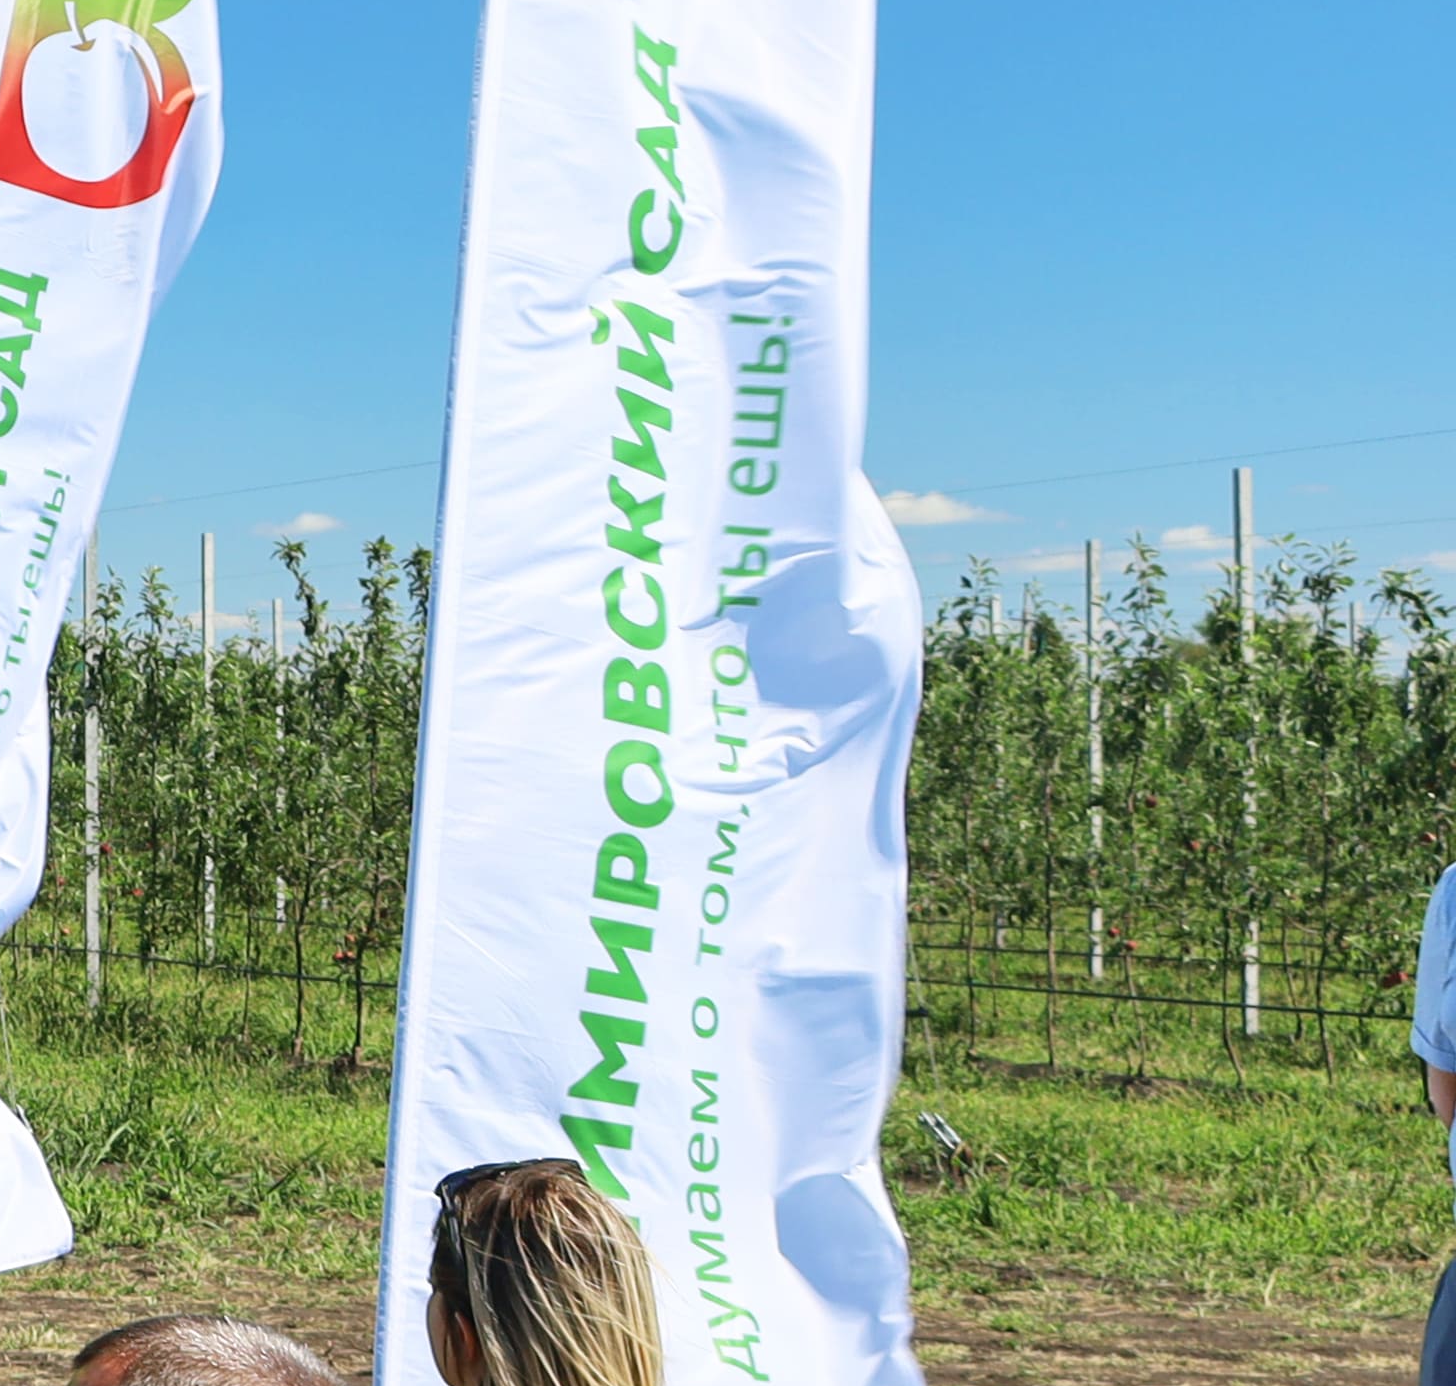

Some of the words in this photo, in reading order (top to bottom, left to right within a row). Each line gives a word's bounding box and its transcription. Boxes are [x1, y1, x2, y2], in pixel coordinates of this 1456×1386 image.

[726, 312, 796, 499] ешь!
[559, 301, 676, 1231] ИМИРОВСКИЙ
[628, 25, 685, 277] САД
[713, 523, 772, 619] ты
[708, 643, 750, 775] что
[692, 996, 720, 1040] о
[684, 1070, 770, 1383] думаем
